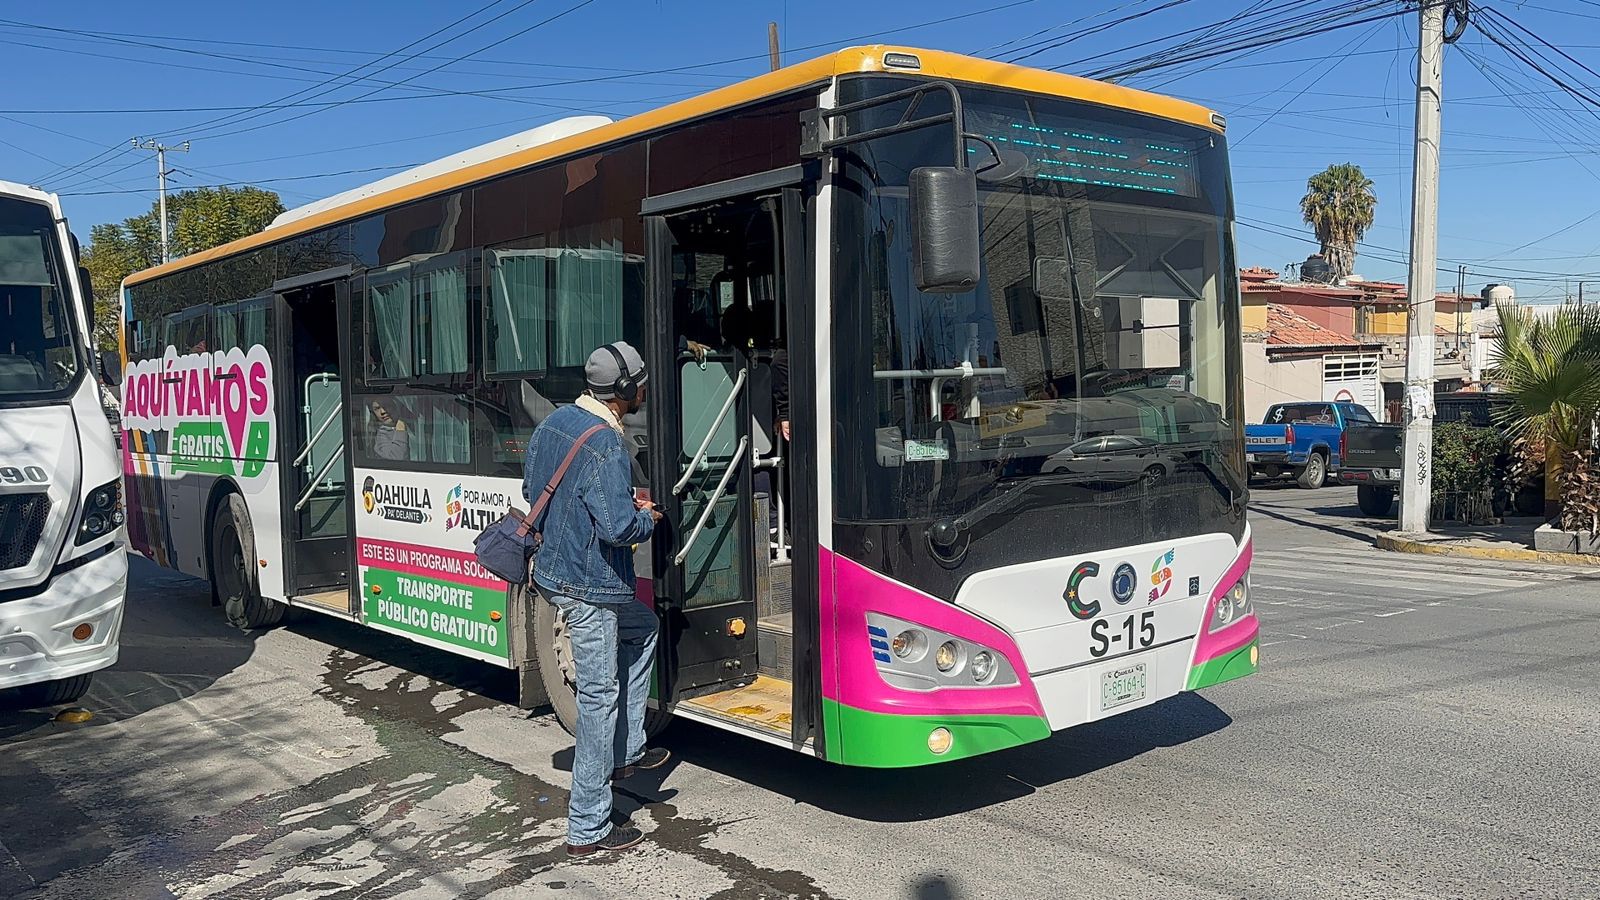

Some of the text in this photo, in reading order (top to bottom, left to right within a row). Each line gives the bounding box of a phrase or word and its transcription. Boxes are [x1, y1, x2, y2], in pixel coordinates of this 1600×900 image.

[179, 434, 224, 463] GRATIS
[0, 466, 49, 484] 90
[464, 489, 512, 508] POR AMOR A
[396, 509, 420, 521] DELANTE
[362, 543, 383, 560] ESTE
[384, 546, 395, 562] ES
[397, 549, 409, 565] UN
[410, 551, 462, 575] PROGRAMA
[397, 576, 473, 610] TRANSPORTE
[377, 596, 498, 647] PÚBLICO GRATUITO
[1089, 610, 1155, 657] S-15
[1103, 672, 1145, 699] C-85164-C
